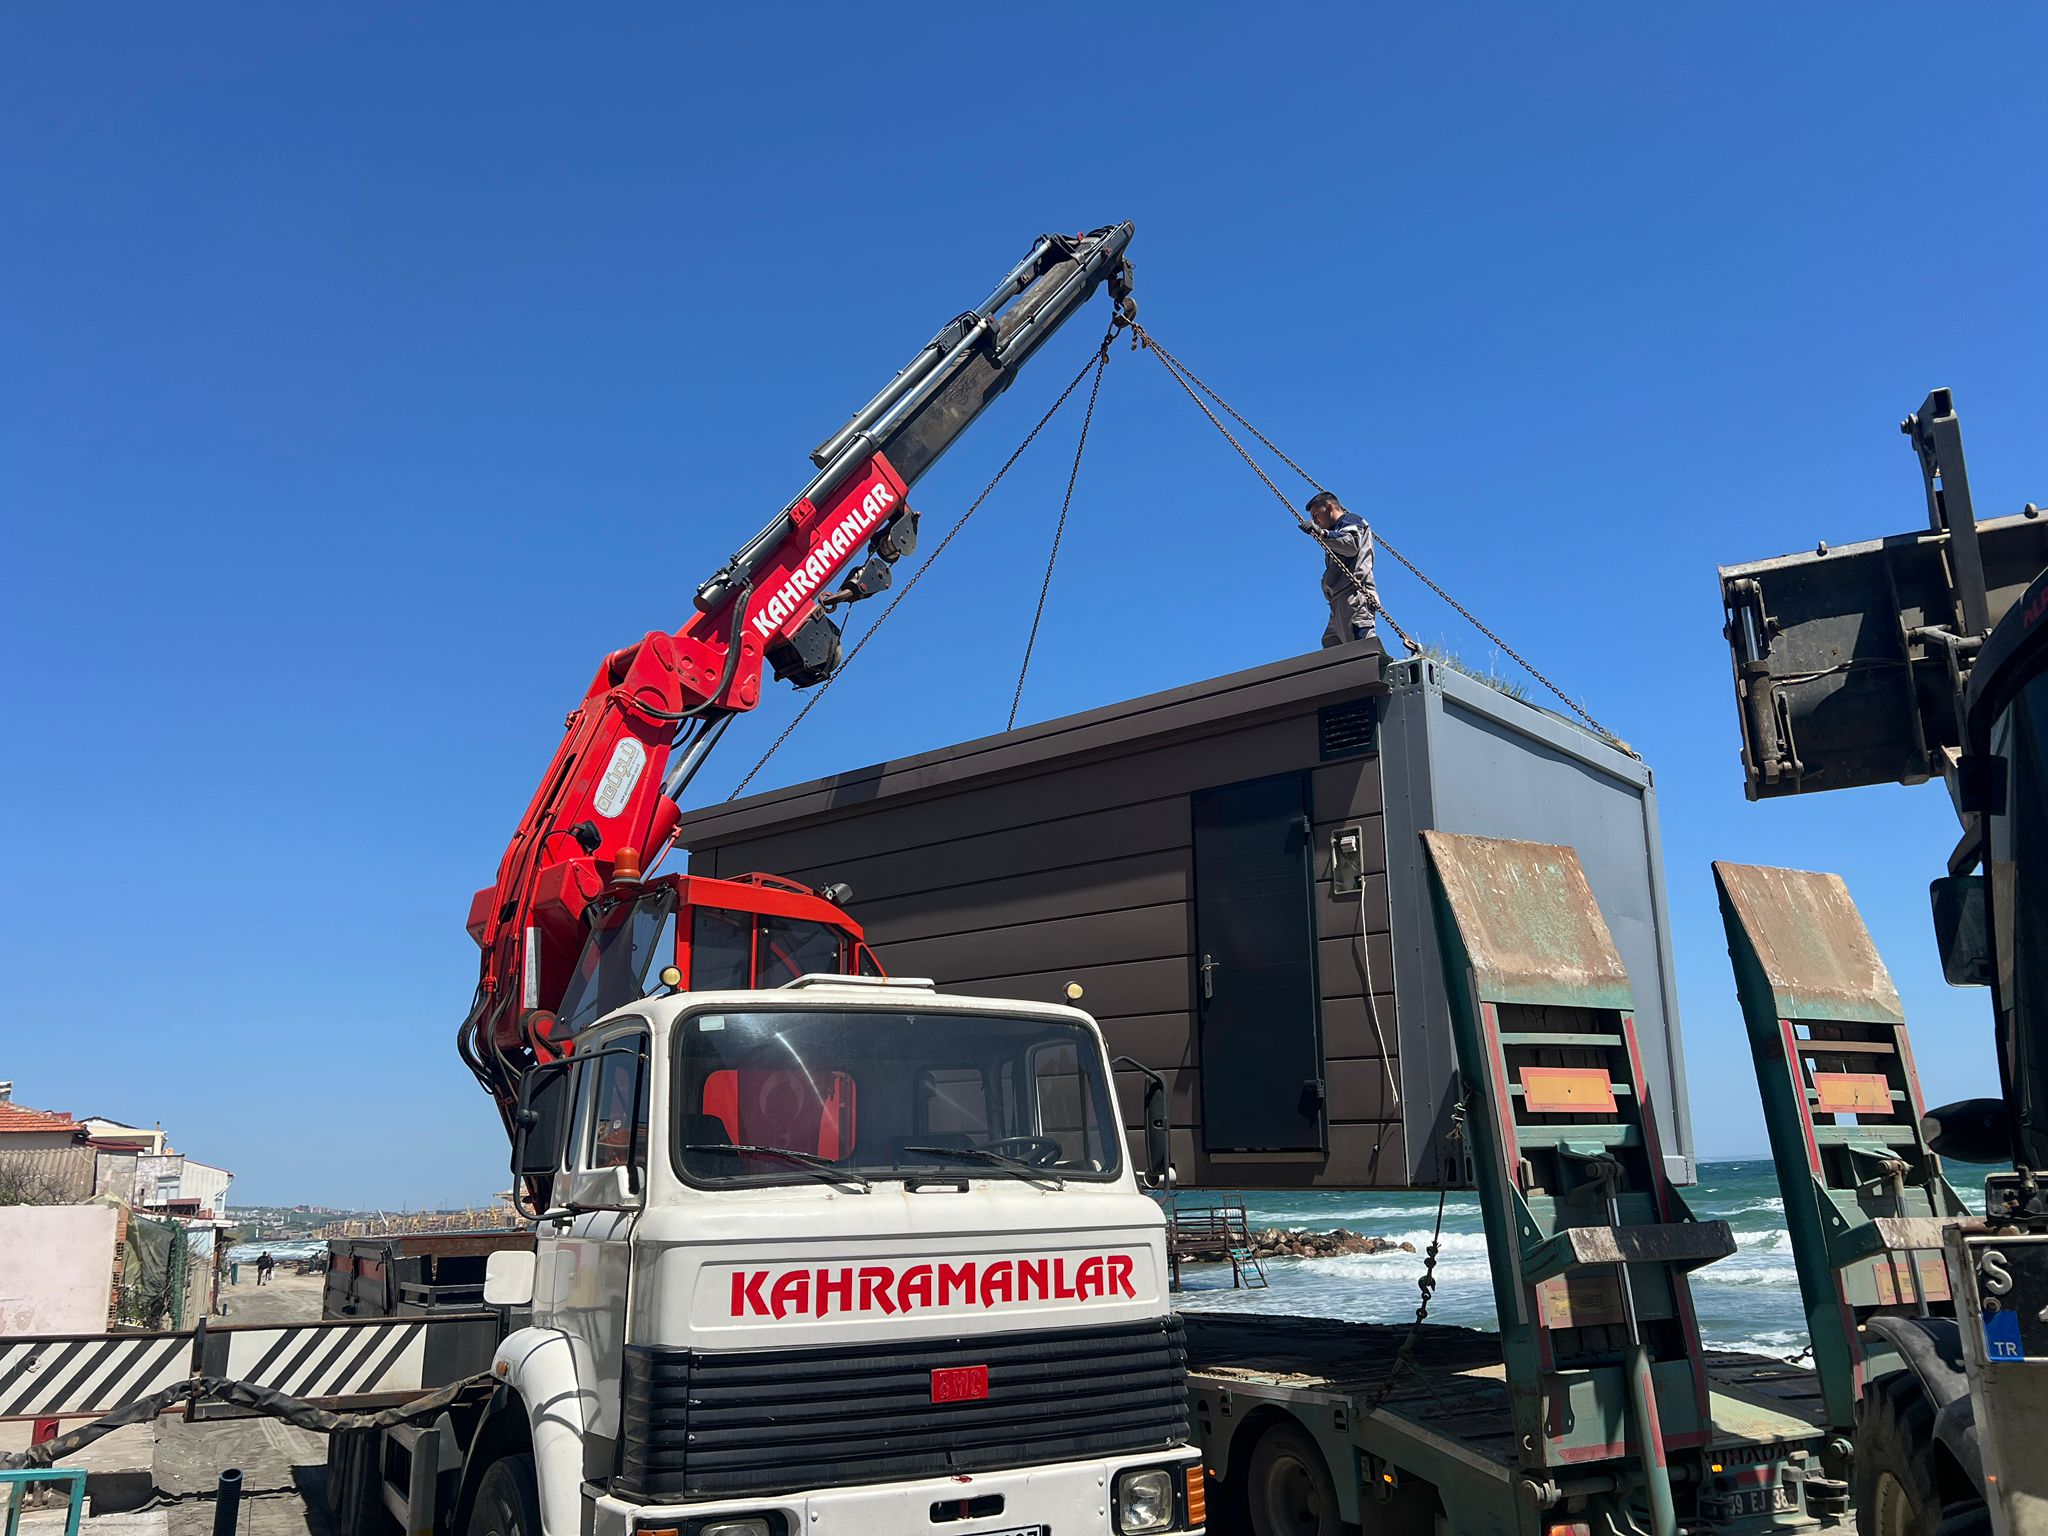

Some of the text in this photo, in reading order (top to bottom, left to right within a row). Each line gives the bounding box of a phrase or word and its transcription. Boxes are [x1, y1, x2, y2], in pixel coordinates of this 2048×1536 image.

[751, 483, 894, 638] KAHRAMANLAR
[602, 742, 637, 801] GÜÇLÜ
[730, 1255, 1137, 1320] KAHRAMANLAR
[1981, 1250, 2013, 1295] S
[1993, 1342, 2018, 1356] TR
[939, 1369, 982, 1399] BMC
